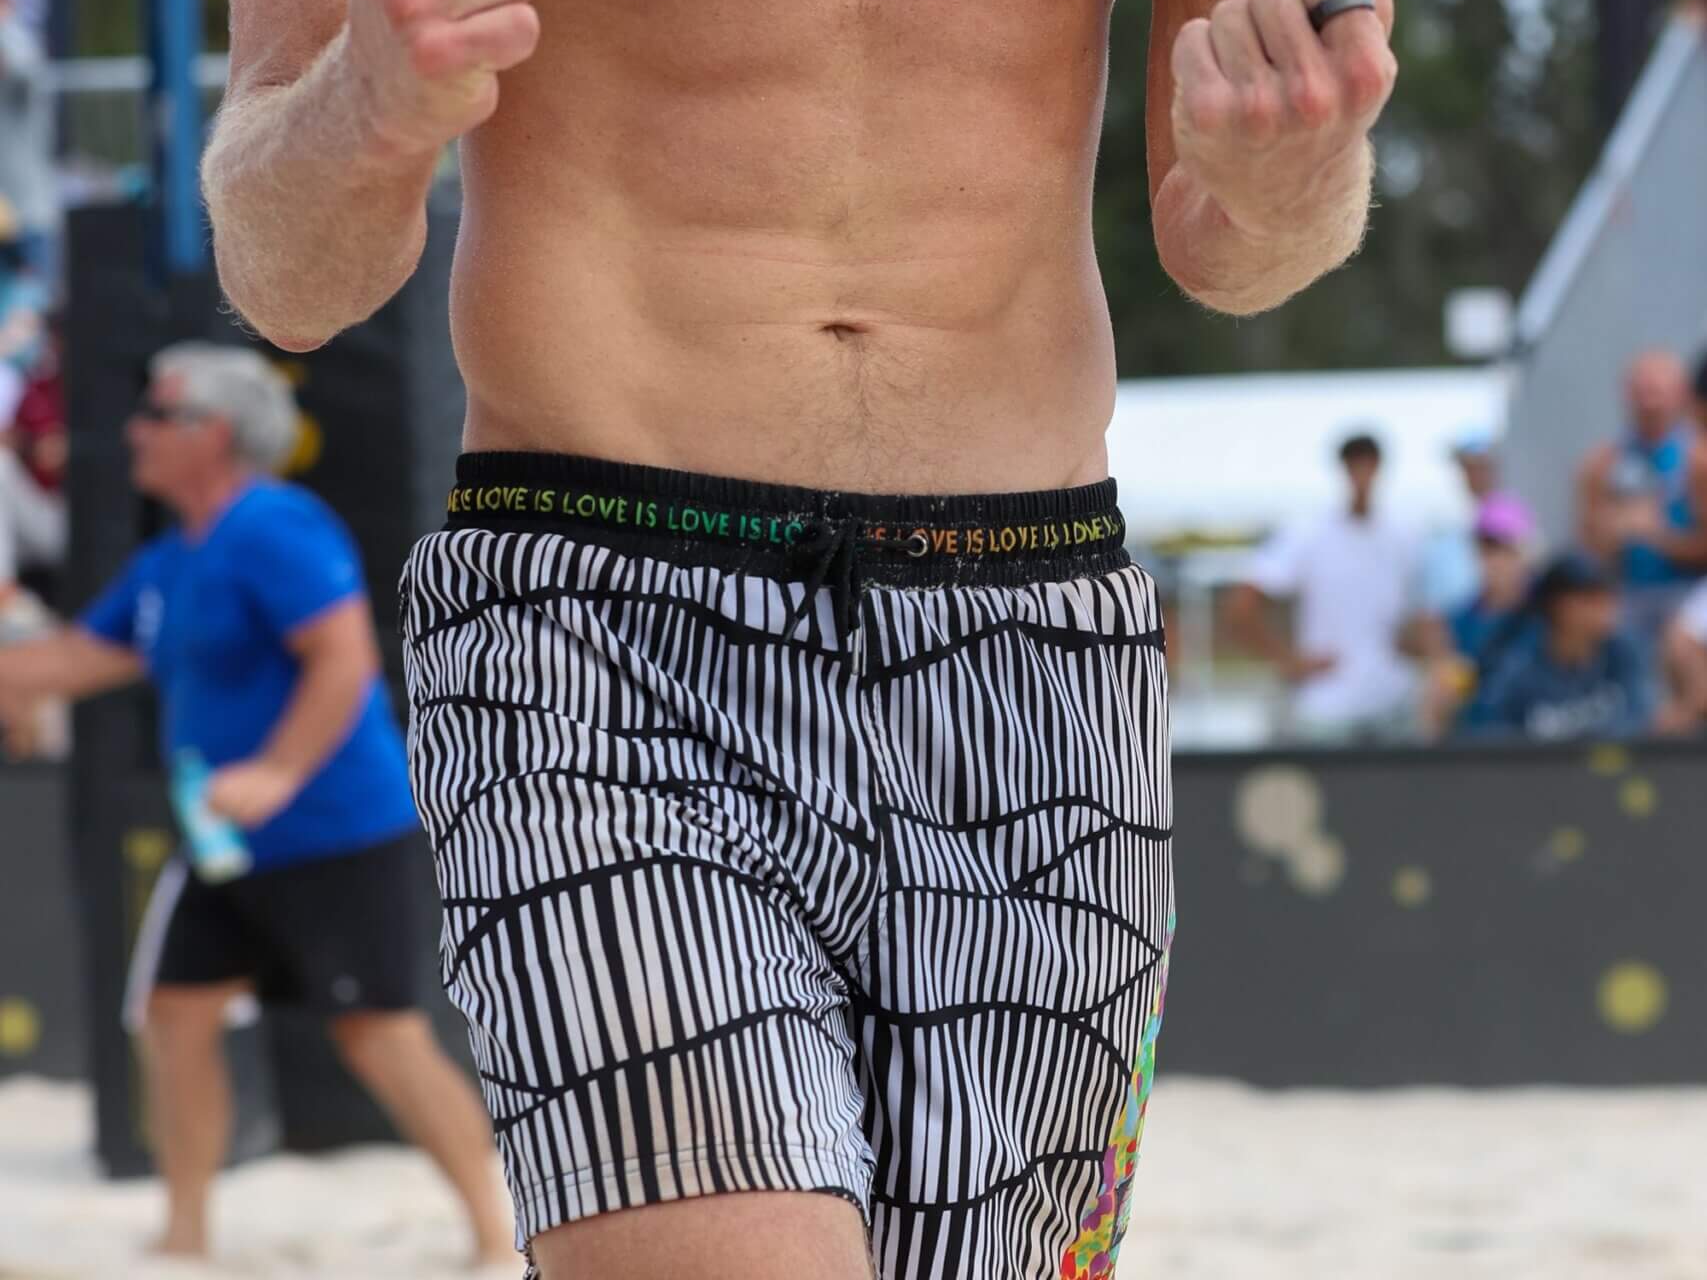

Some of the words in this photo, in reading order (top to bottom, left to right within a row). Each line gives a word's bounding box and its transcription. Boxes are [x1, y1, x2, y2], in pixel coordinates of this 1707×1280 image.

[476, 486, 527, 511] LOVE
[535, 489, 555, 512] IS
[563, 492, 629, 523] LOVE
[635, 502, 657, 528] IS
[667, 505, 730, 536] LOVE
[739, 515, 762, 540] IS
[966, 529, 984, 554] IS
[988, 527, 1039, 552] LOVE
[1043, 524, 1060, 549] IS
[1063, 517, 1105, 545] LOVE
